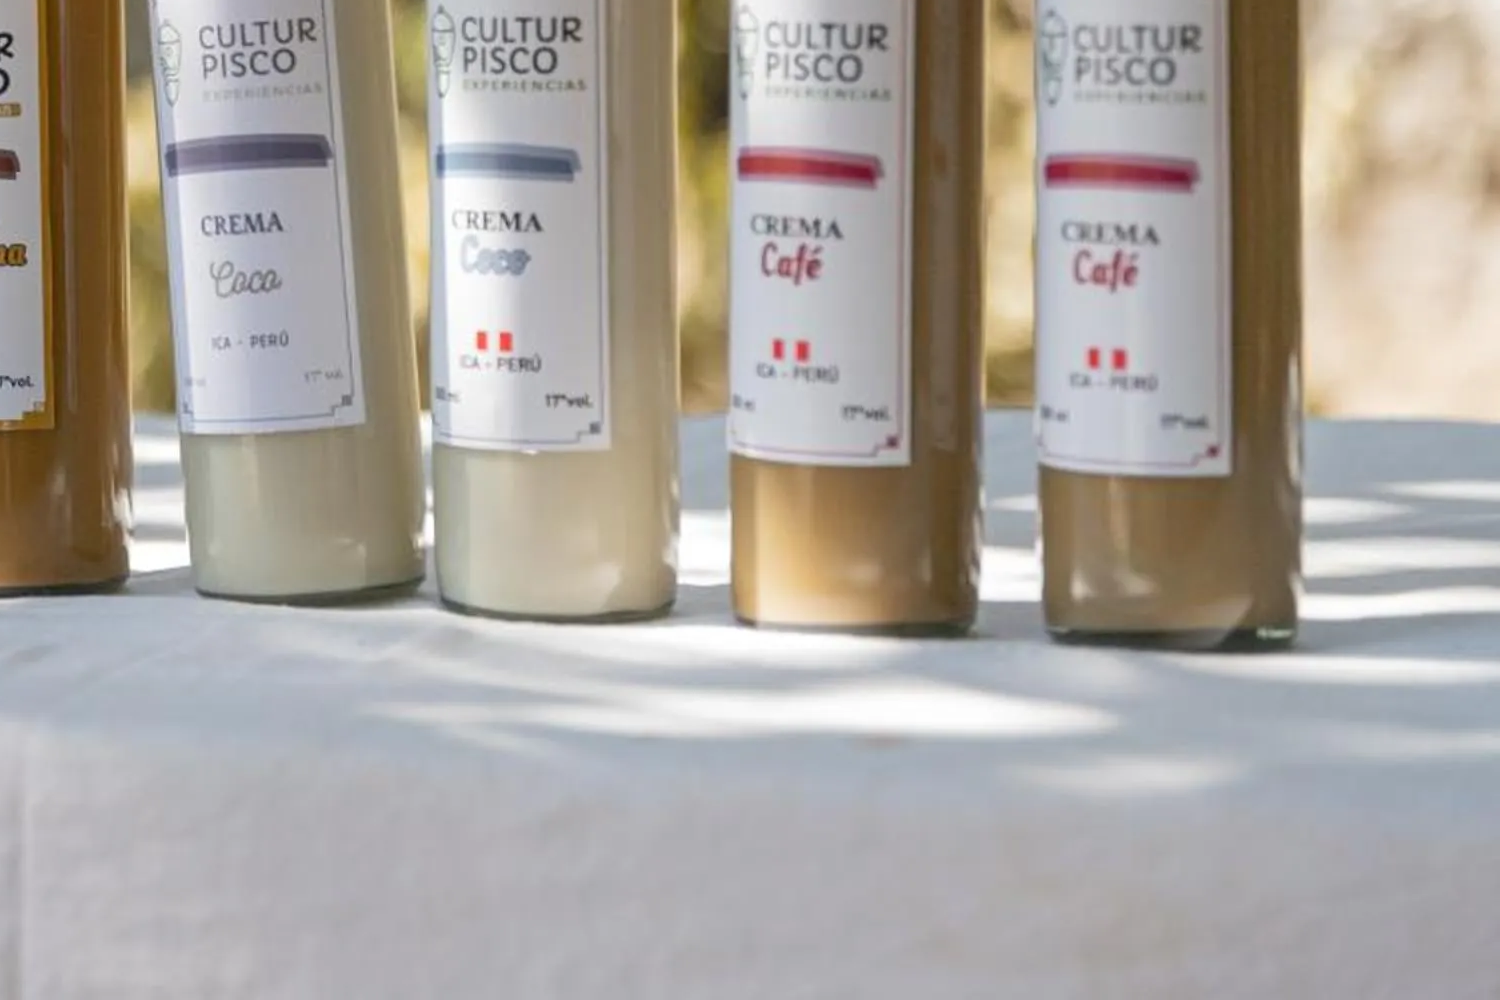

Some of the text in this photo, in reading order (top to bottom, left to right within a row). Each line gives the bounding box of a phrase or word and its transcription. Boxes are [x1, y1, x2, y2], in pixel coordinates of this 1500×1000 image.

[198, 16, 318, 50] CULTUR
[460, 15, 583, 44] CULTUR
[763, 22, 890, 52] CULTUR
[1071, 24, 1203, 54] CULTUR
[202, 47, 298, 80] PISCO
[462, 46, 558, 75] PISCO
[764, 54, 864, 83] PISCO
[1074, 55, 1178, 87] PISCO
[200, 210, 284, 237] CREMA
[451, 209, 545, 234] CREMA
[750, 213, 844, 240] CREMA
[1060, 220, 1161, 246] CREMA
[459, 234, 532, 276] Coco
[760, 241, 823, 287] Café
[209, 259, 283, 298] Coco
[1071, 248, 1140, 294] Café
[249, 331, 290, 350] PERÚ
[496, 352, 542, 373] PERÚ
